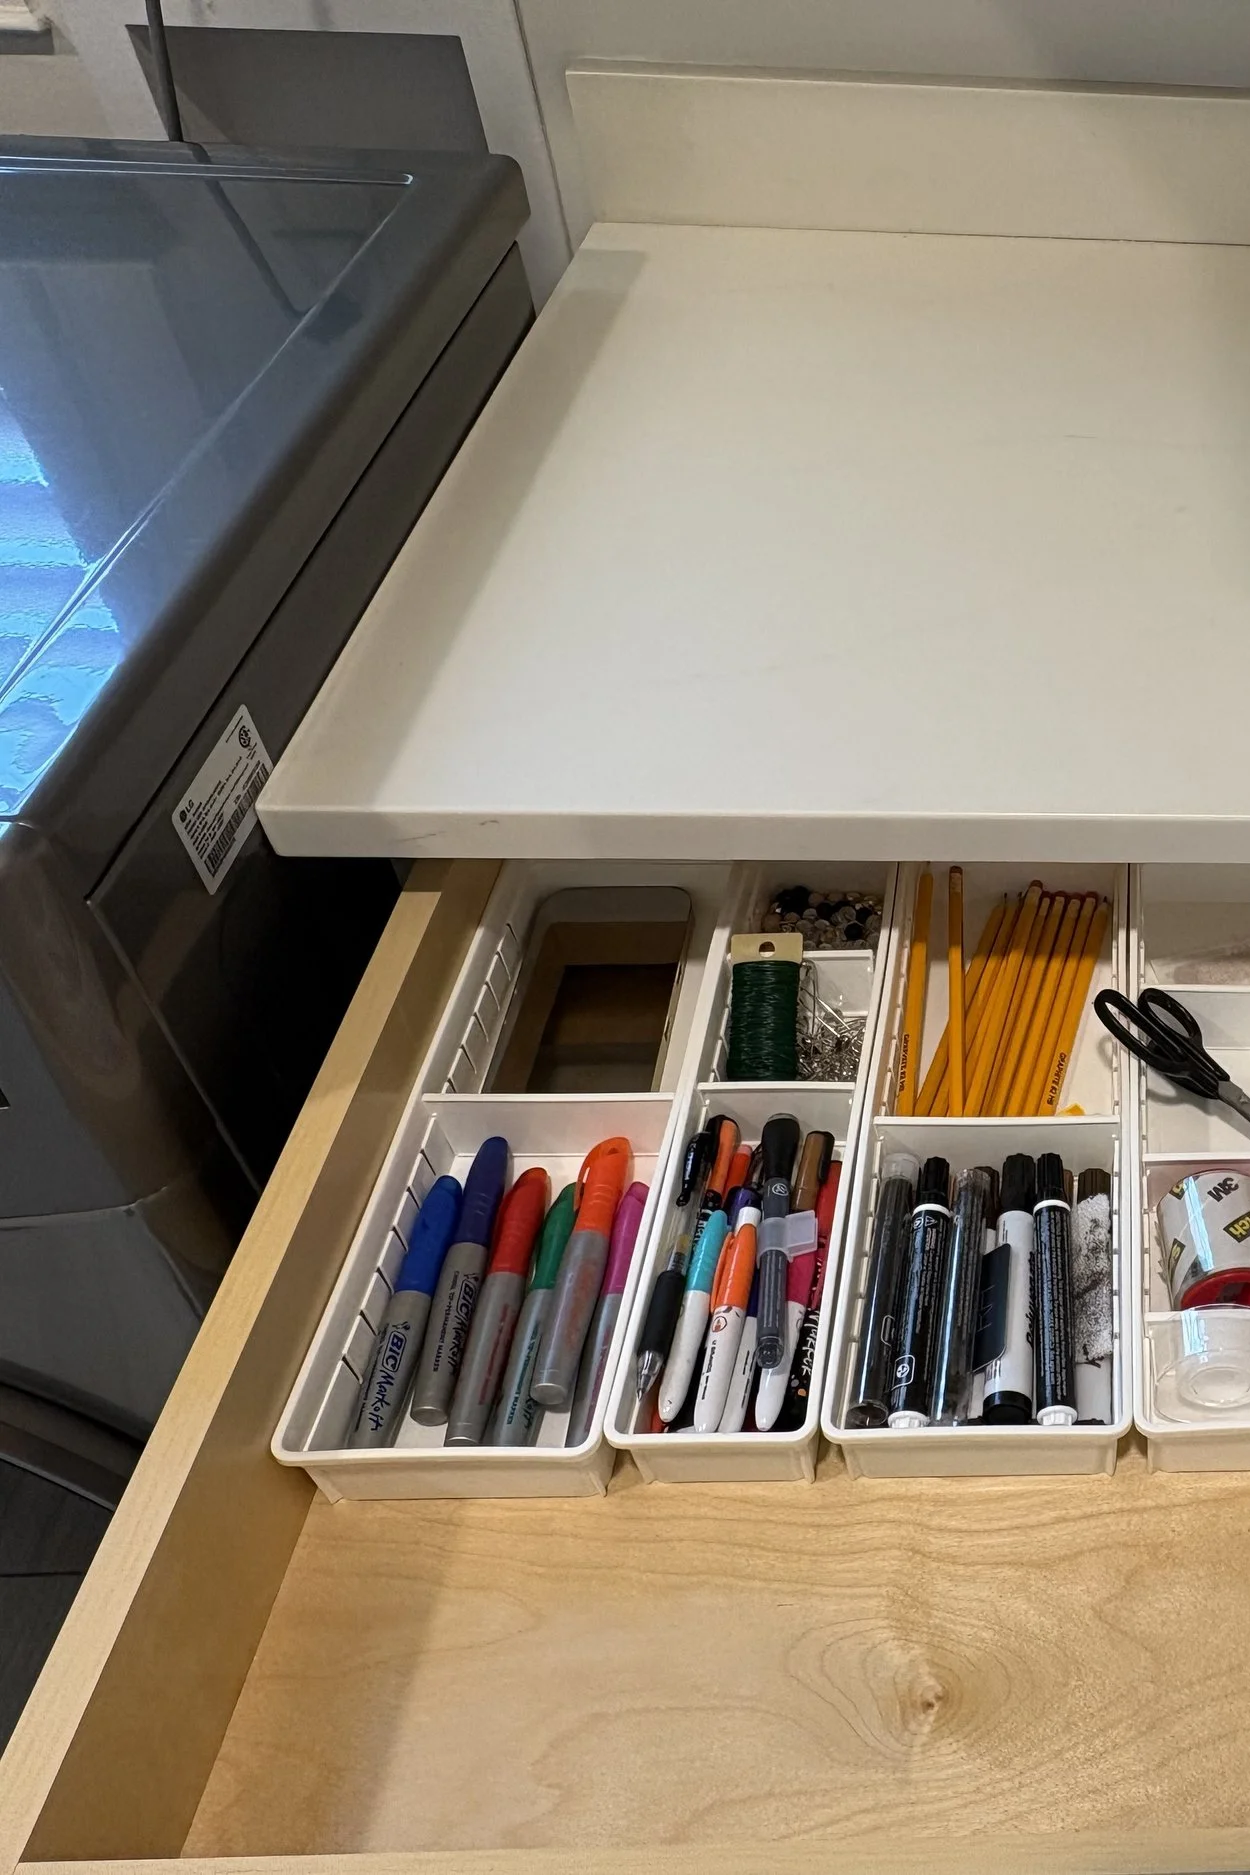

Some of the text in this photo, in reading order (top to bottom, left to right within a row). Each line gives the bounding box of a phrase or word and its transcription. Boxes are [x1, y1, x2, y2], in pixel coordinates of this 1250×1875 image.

[1208, 1177, 1239, 1202] 3M
[458, 1282, 476, 1319] BIC
[386, 1336, 404, 1370] BIC
